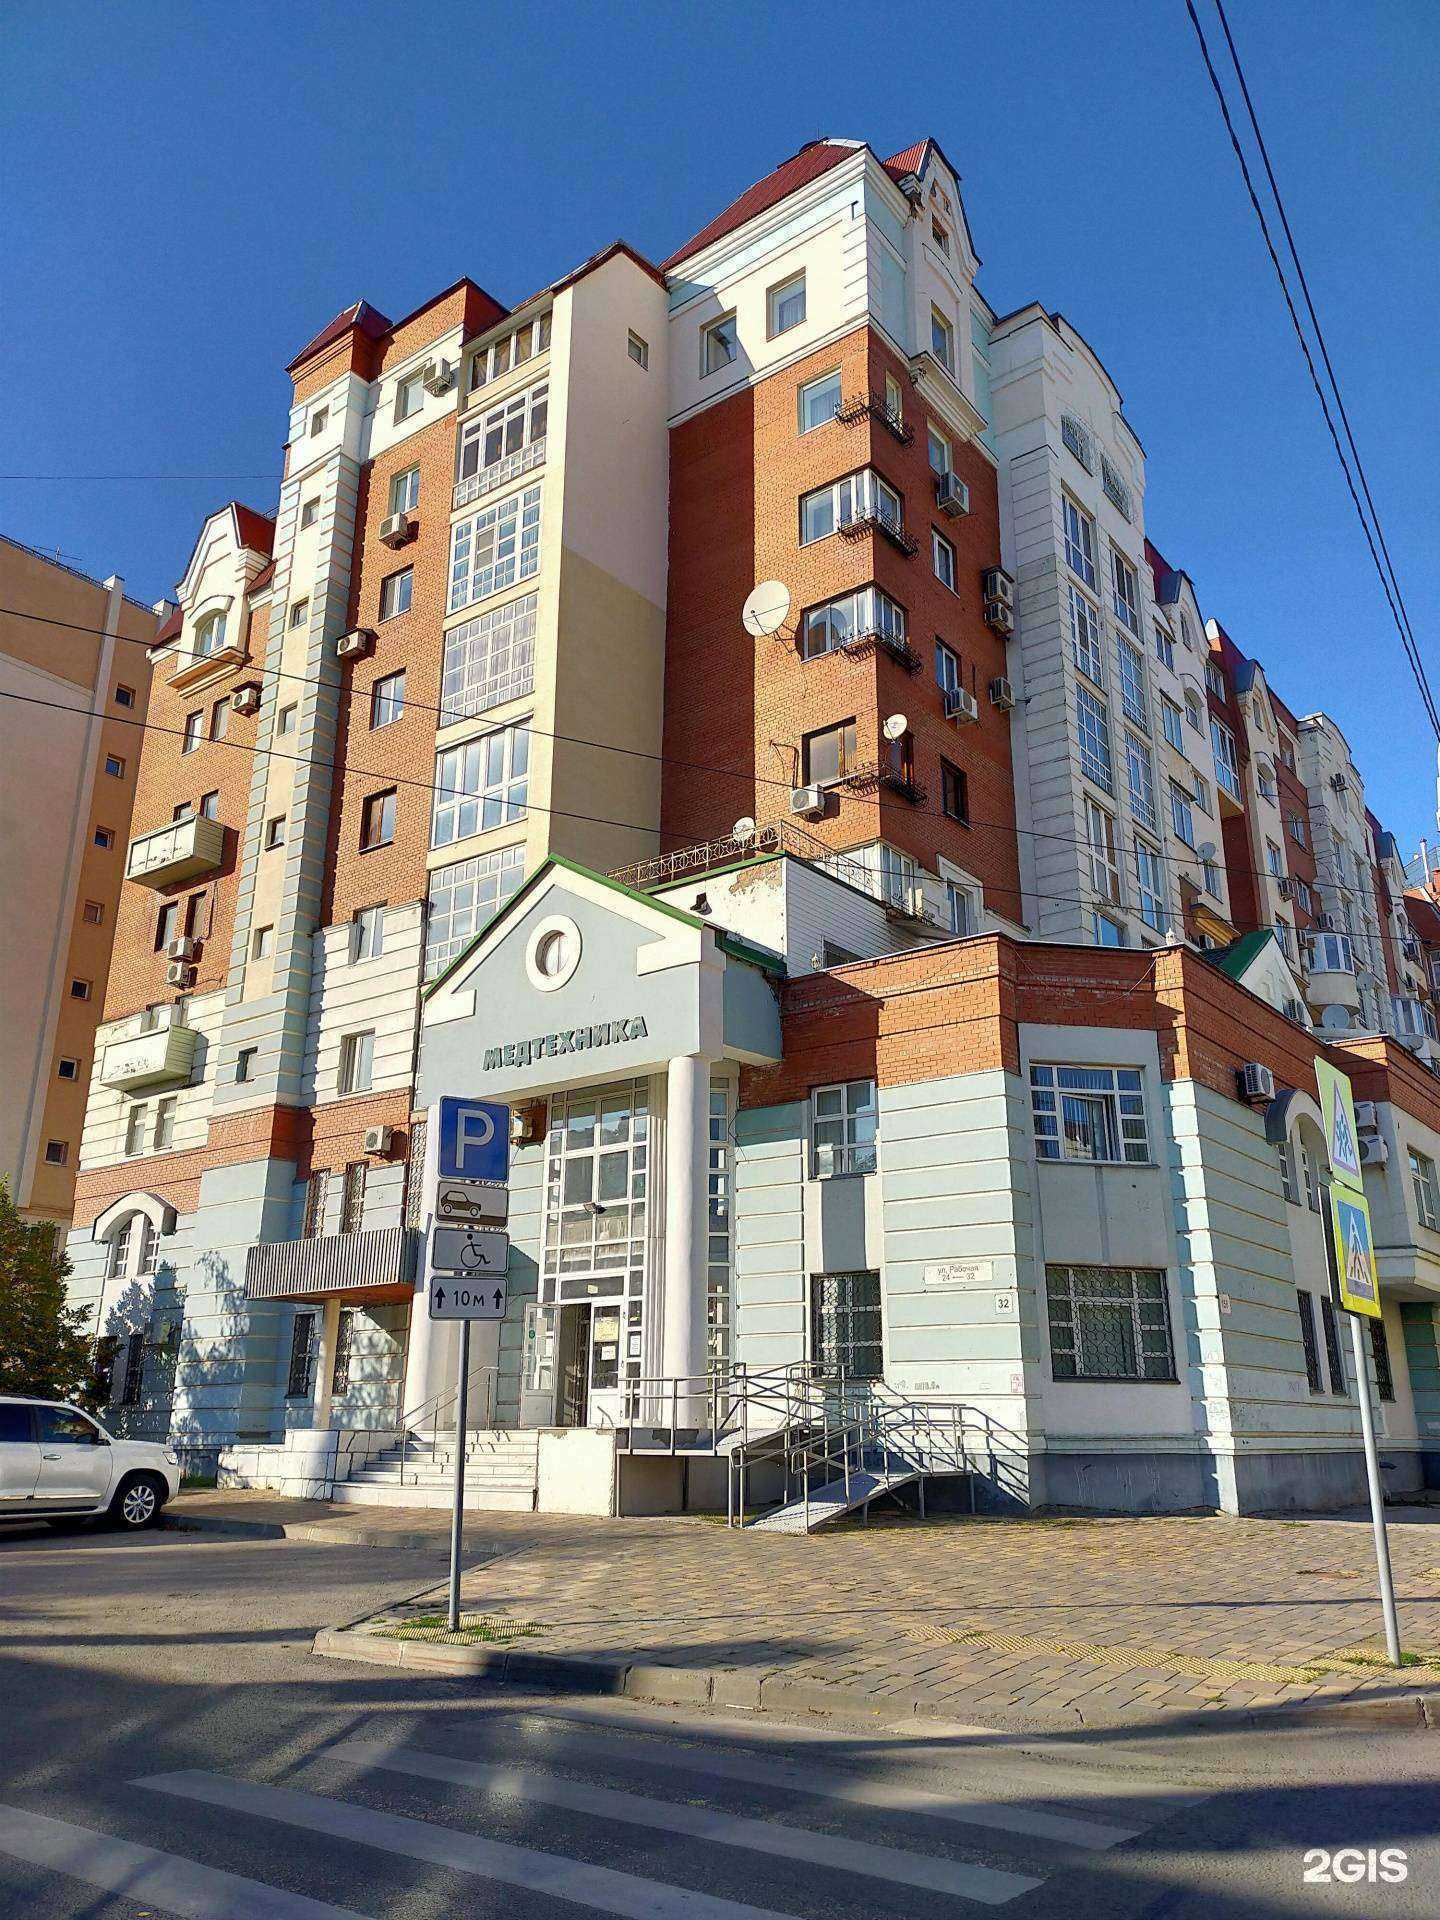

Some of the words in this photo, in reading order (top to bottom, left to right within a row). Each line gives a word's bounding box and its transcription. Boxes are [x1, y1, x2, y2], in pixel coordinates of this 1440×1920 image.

[482, 1016, 649, 1071] МЕДТЕХНИКА
[455, 1108, 496, 1169] P
[950, 1265, 979, 1273] Рабочая
[998, 1299, 1009, 1308] 32
